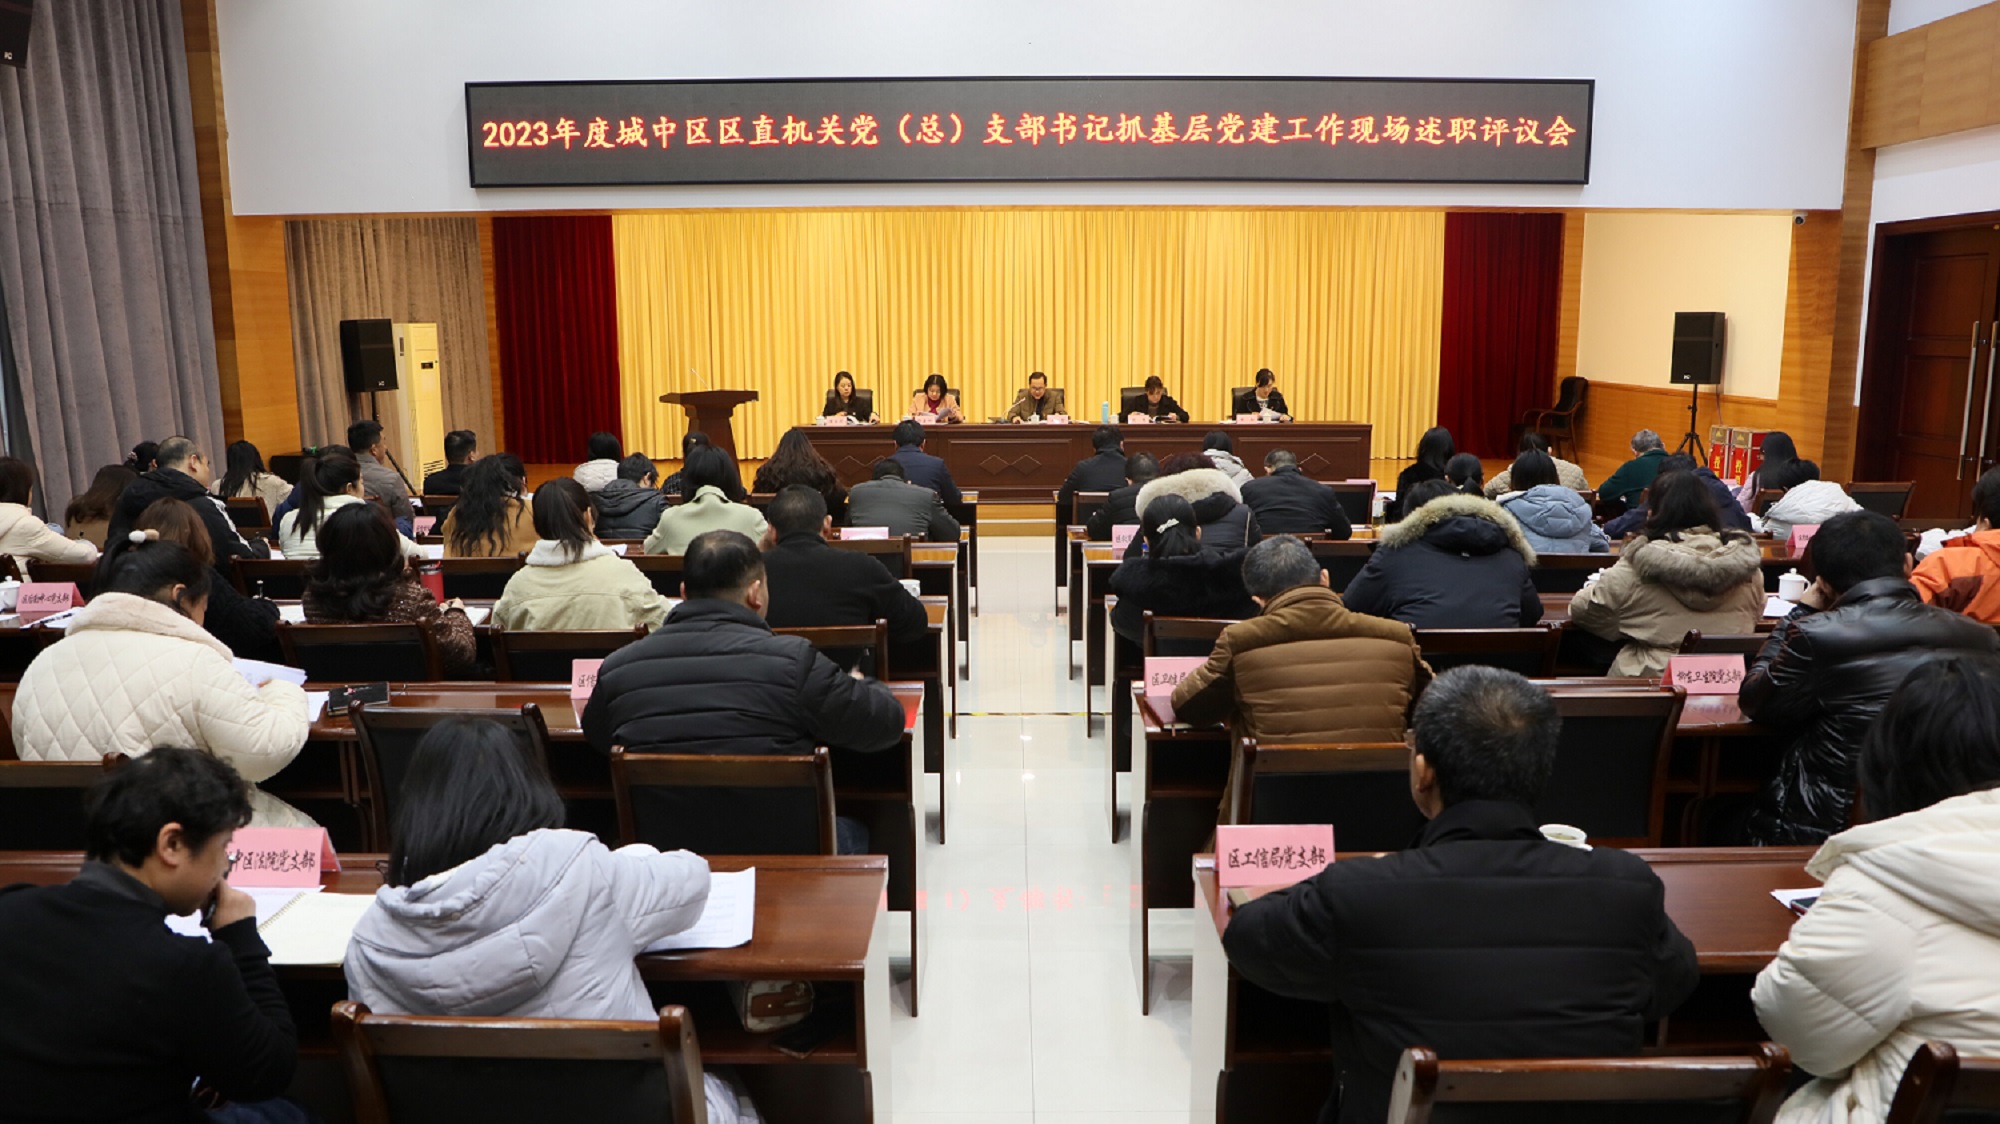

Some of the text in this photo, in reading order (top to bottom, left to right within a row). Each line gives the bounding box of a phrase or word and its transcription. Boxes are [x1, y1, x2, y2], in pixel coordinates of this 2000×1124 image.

[482, 112, 1577, 150] 2023年度城中区区直机关党（总）支部书记抓基层党建工作现场述职评议会
[1228, 845, 1326, 870] 区工信局党支部
